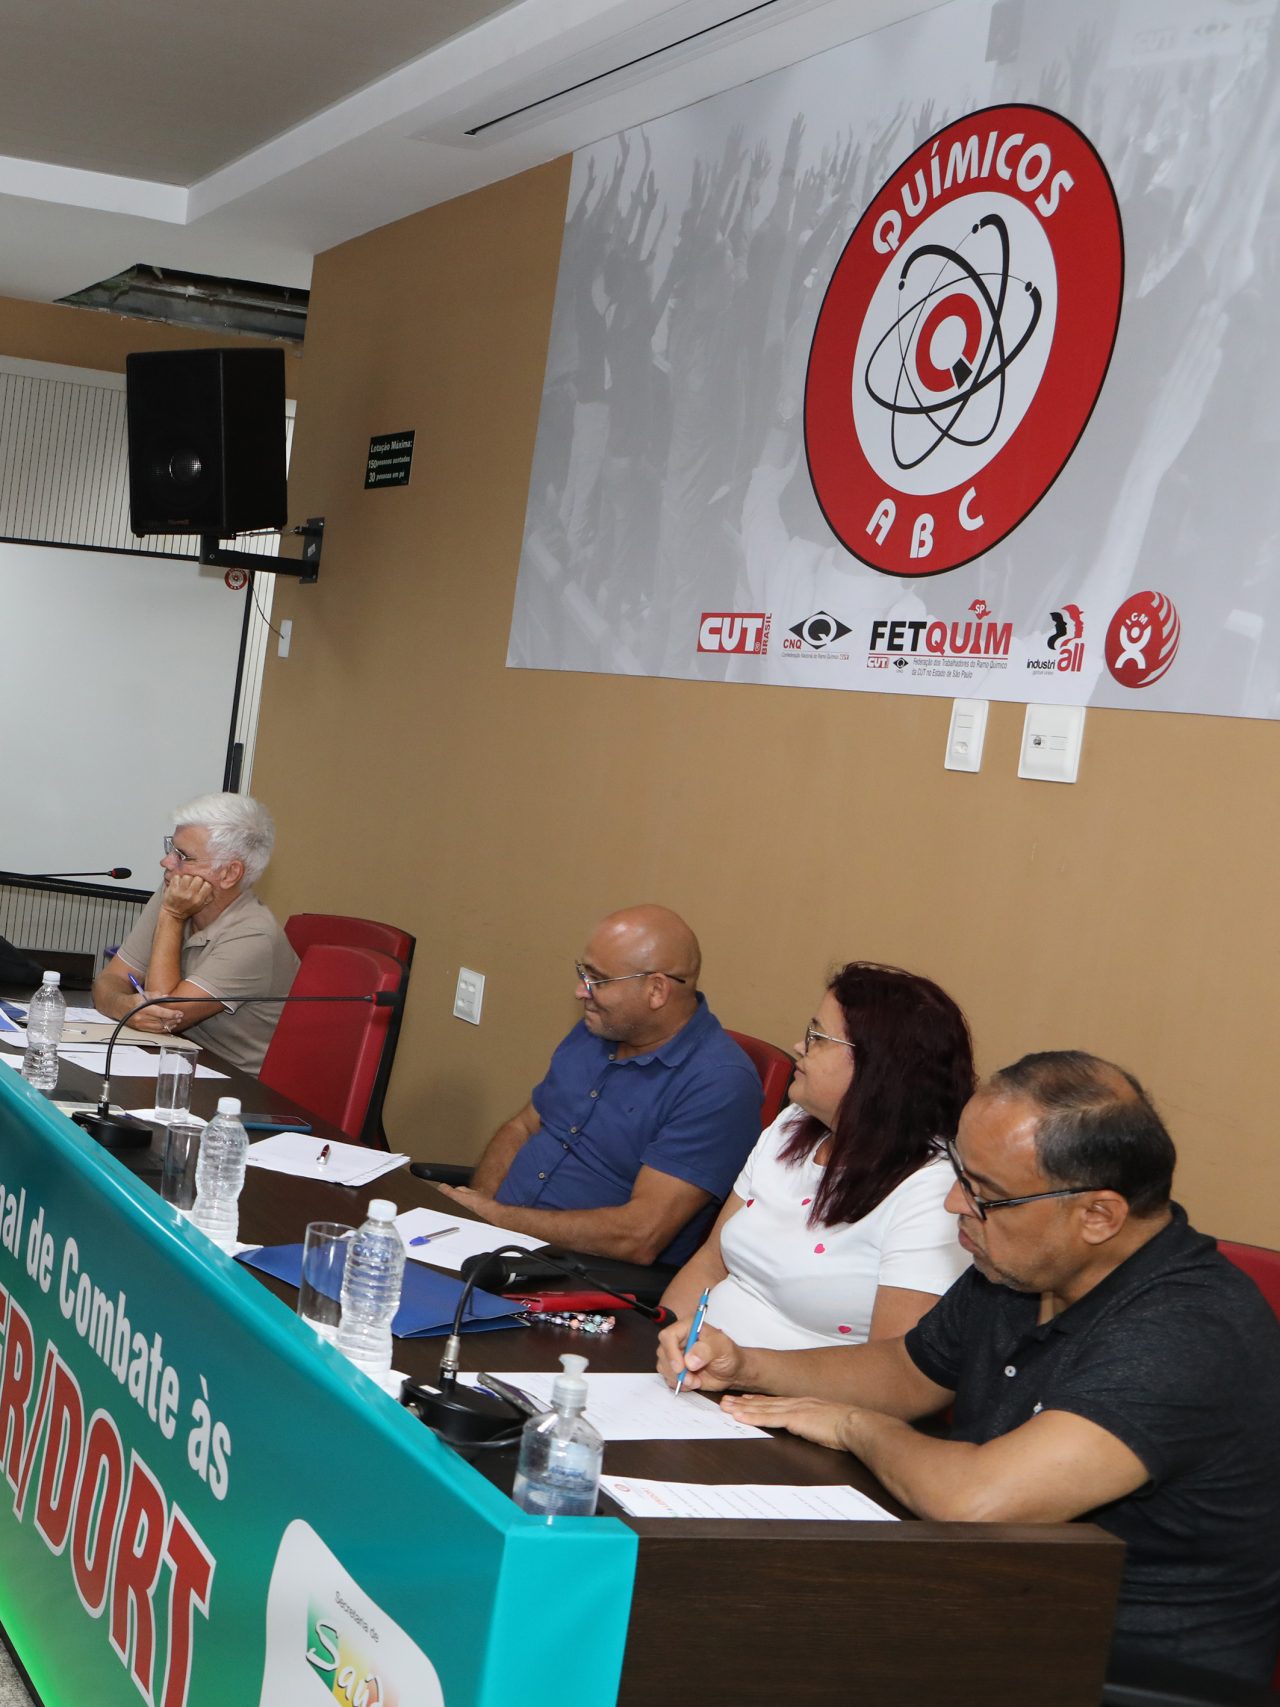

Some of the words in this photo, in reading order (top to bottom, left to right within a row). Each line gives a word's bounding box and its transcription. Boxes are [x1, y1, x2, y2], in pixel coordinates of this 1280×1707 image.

[873, 131, 1075, 254] QUÍMICOS
[975, 604, 985, 614] SP
[1125, 612, 1149, 627] ICM
[699, 617, 764, 651] CUT
[762, 613, 772, 655] BRASIL
[783, 639, 802, 650] CNQ
[870, 621, 1013, 656] FETQUIM
[1027, 658, 1055, 670] industri
[1057, 643, 1085, 673] all
[26, 1206, 54, 1293] de
[59, 1237, 180, 1440] Combate
[187, 1374, 231, 1501] às
